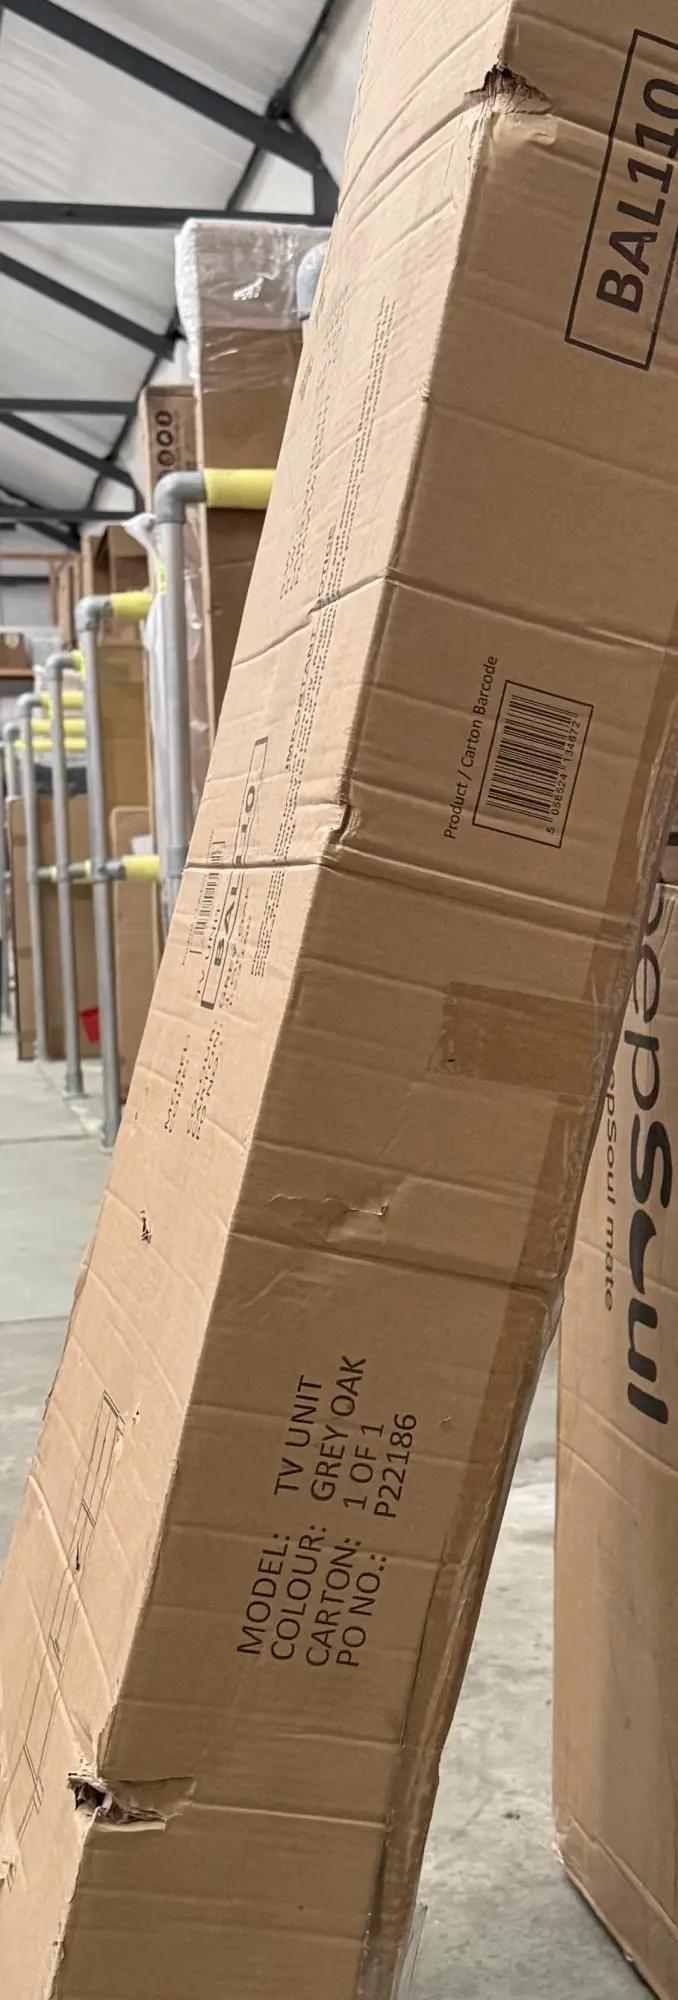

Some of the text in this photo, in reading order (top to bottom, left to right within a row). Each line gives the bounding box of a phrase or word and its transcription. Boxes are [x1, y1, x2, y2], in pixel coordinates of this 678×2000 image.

[596, 77, 678, 314] BAL110
[444, 782, 468, 840] Product
[460, 719, 482, 768] Carton
[472, 656, 498, 716] Barcode
[604, 1216, 616, 1312] mate
[236, 1374, 322, 1655] MODEL: TV UNIT
[271, 1355, 366, 1660] COLOUR: GREY OAK
[306, 1424, 384, 1666] CARTON: 1 OF 1
[336, 1413, 418, 1667] PO NO.: P22186
